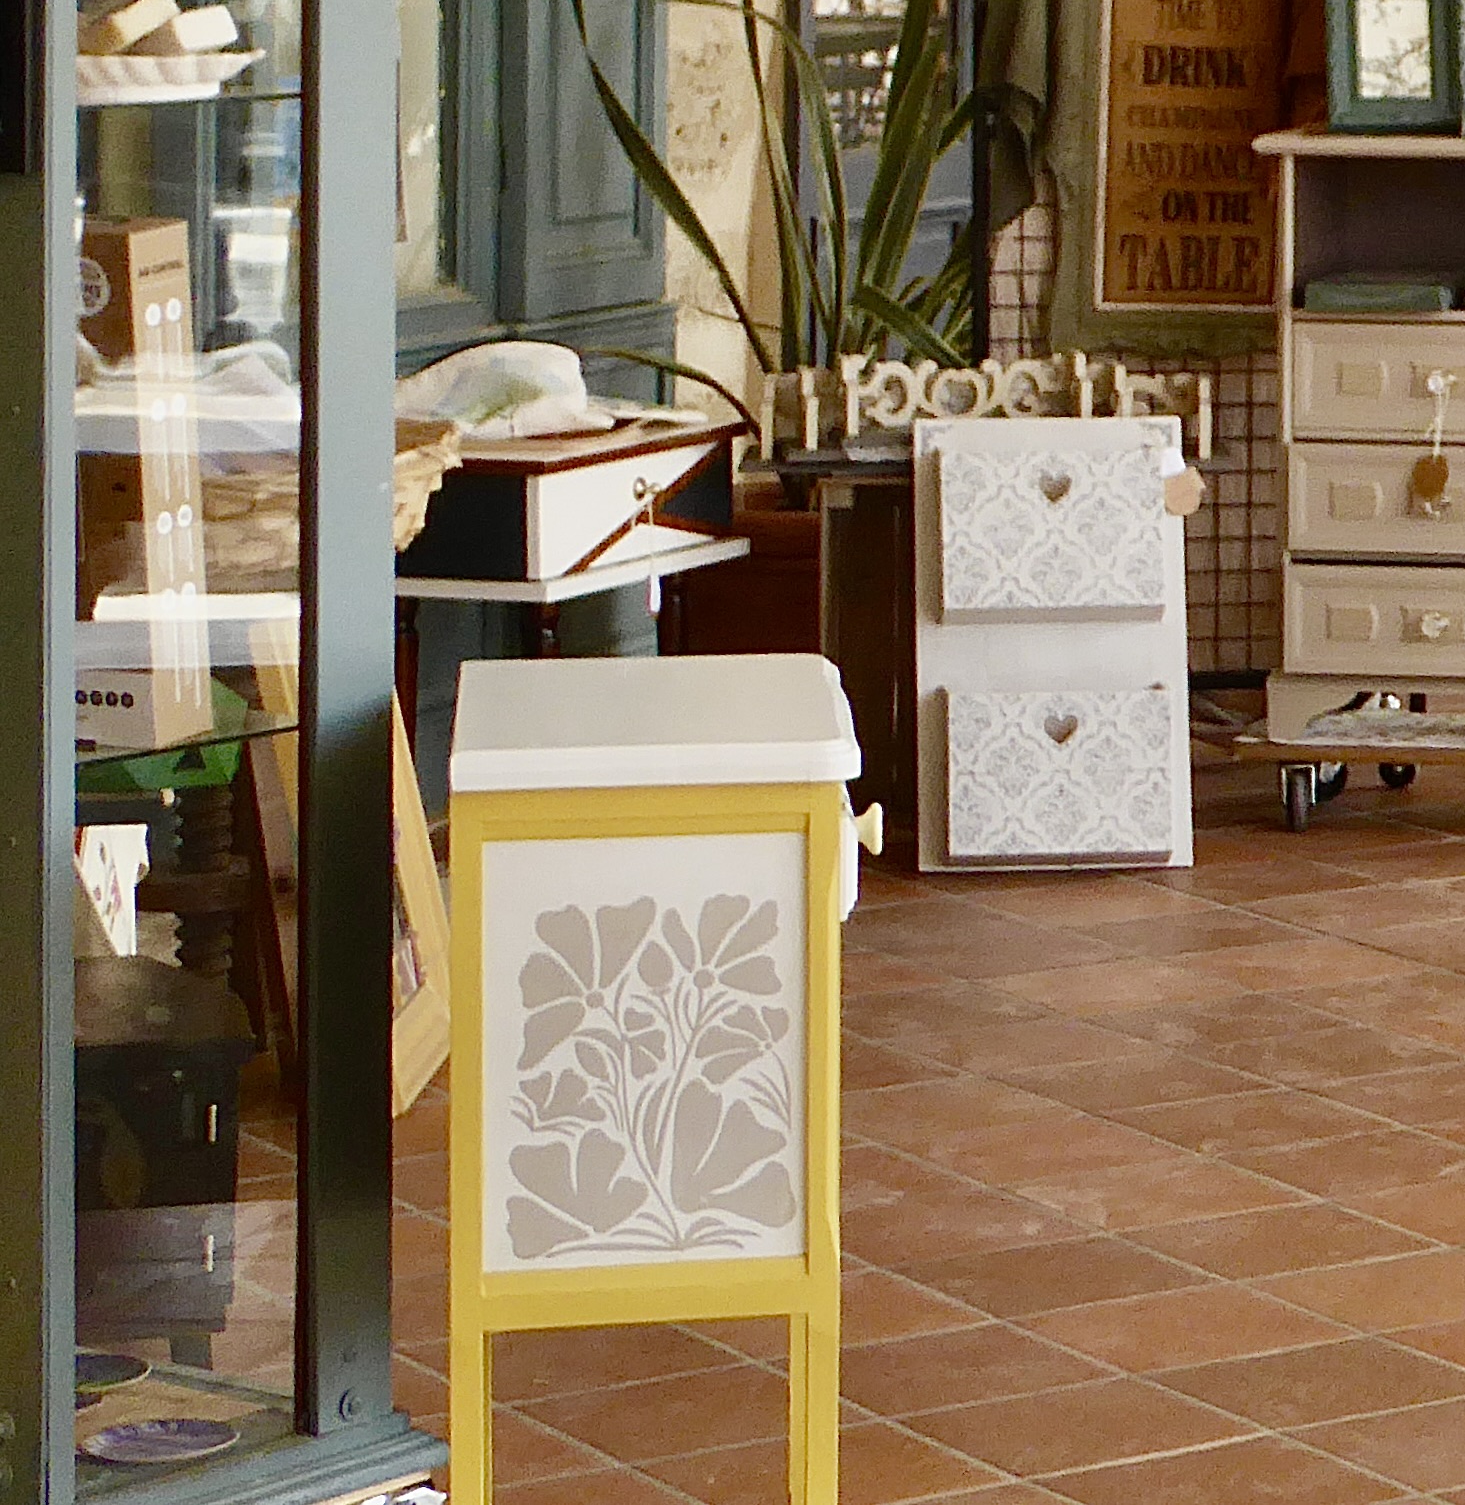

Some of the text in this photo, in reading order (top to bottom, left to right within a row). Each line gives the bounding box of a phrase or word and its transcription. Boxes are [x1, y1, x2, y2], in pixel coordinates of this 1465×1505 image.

[1141, 44, 1248, 88] DRINK
[1160, 190, 1254, 225] ON THE
[1119, 232, 1261, 294] TABLE
